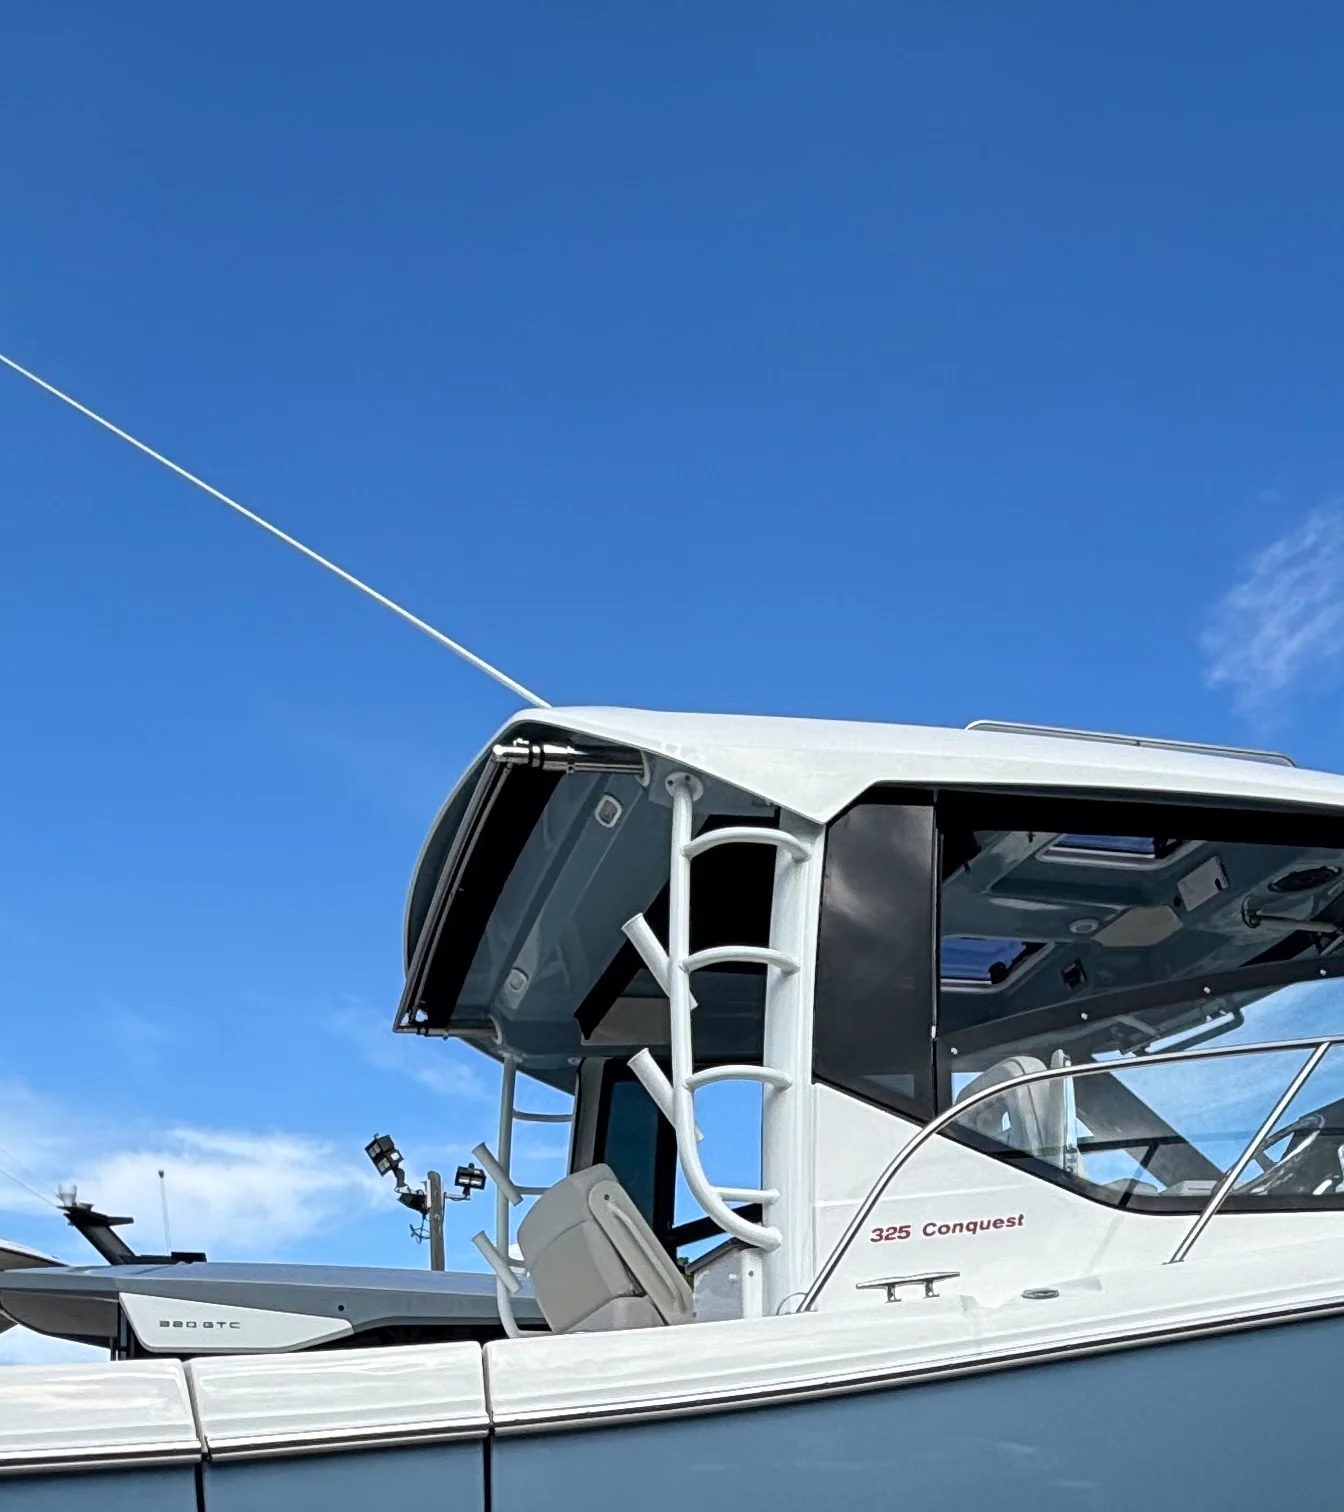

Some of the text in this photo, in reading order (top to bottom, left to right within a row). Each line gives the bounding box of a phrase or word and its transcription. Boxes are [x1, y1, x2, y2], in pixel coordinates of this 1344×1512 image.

[870, 1213, 1025, 1243] 325 Conquest
[203, 1321, 241, 1330] GTC
